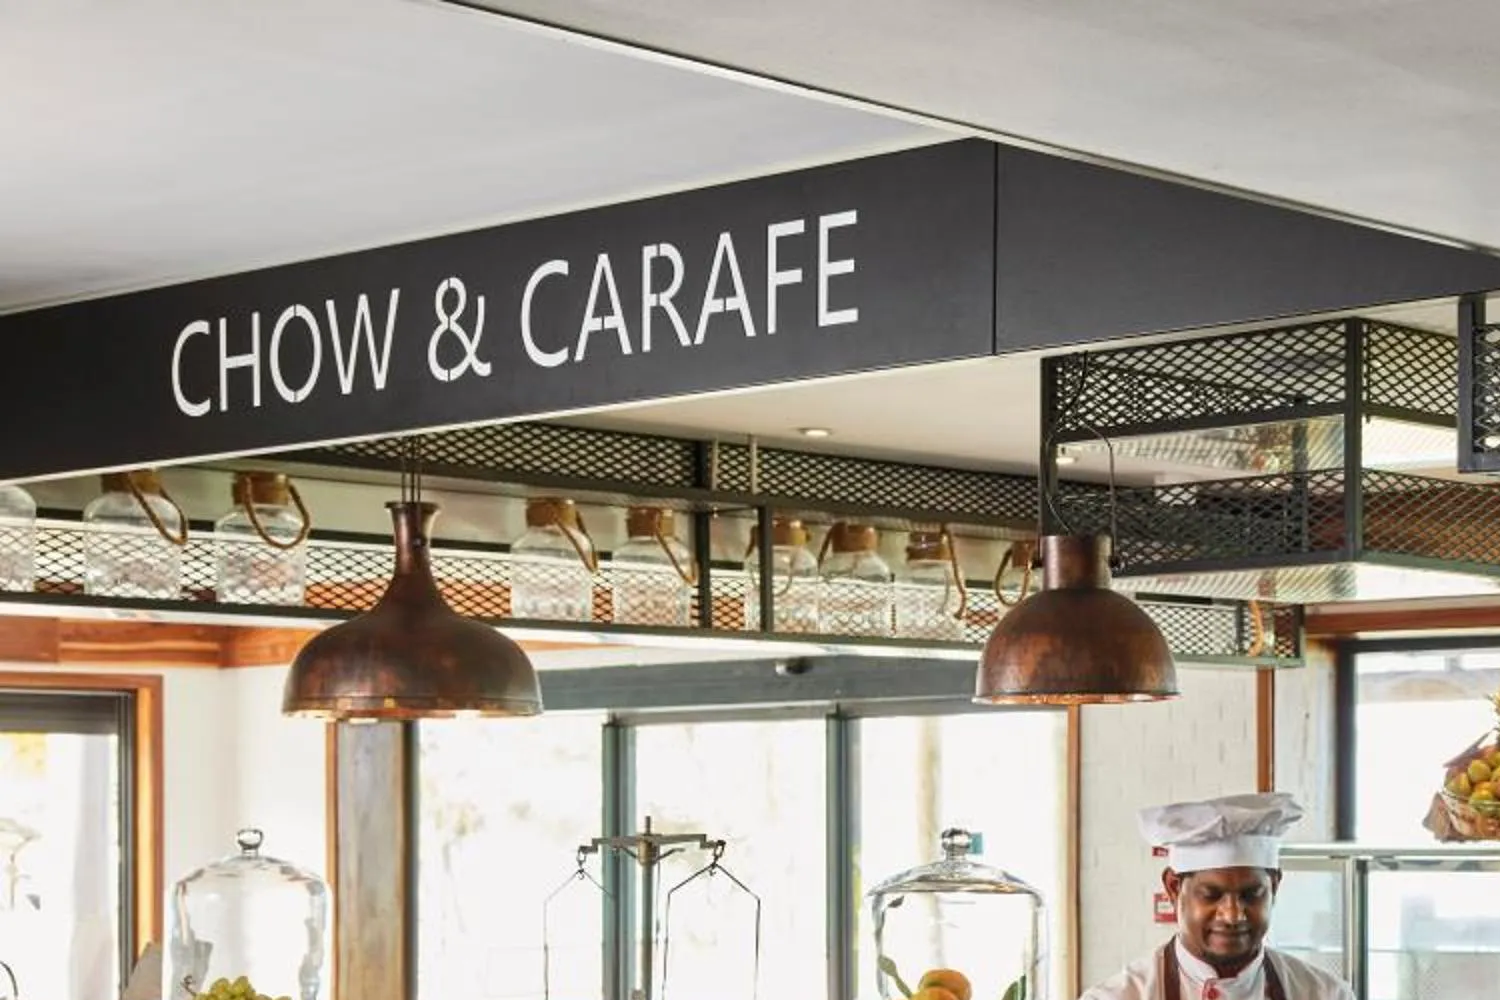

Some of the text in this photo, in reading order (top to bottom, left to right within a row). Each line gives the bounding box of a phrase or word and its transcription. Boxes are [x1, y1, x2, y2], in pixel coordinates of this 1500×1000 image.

[171, 209, 859, 417] CHOW & CARAFE
